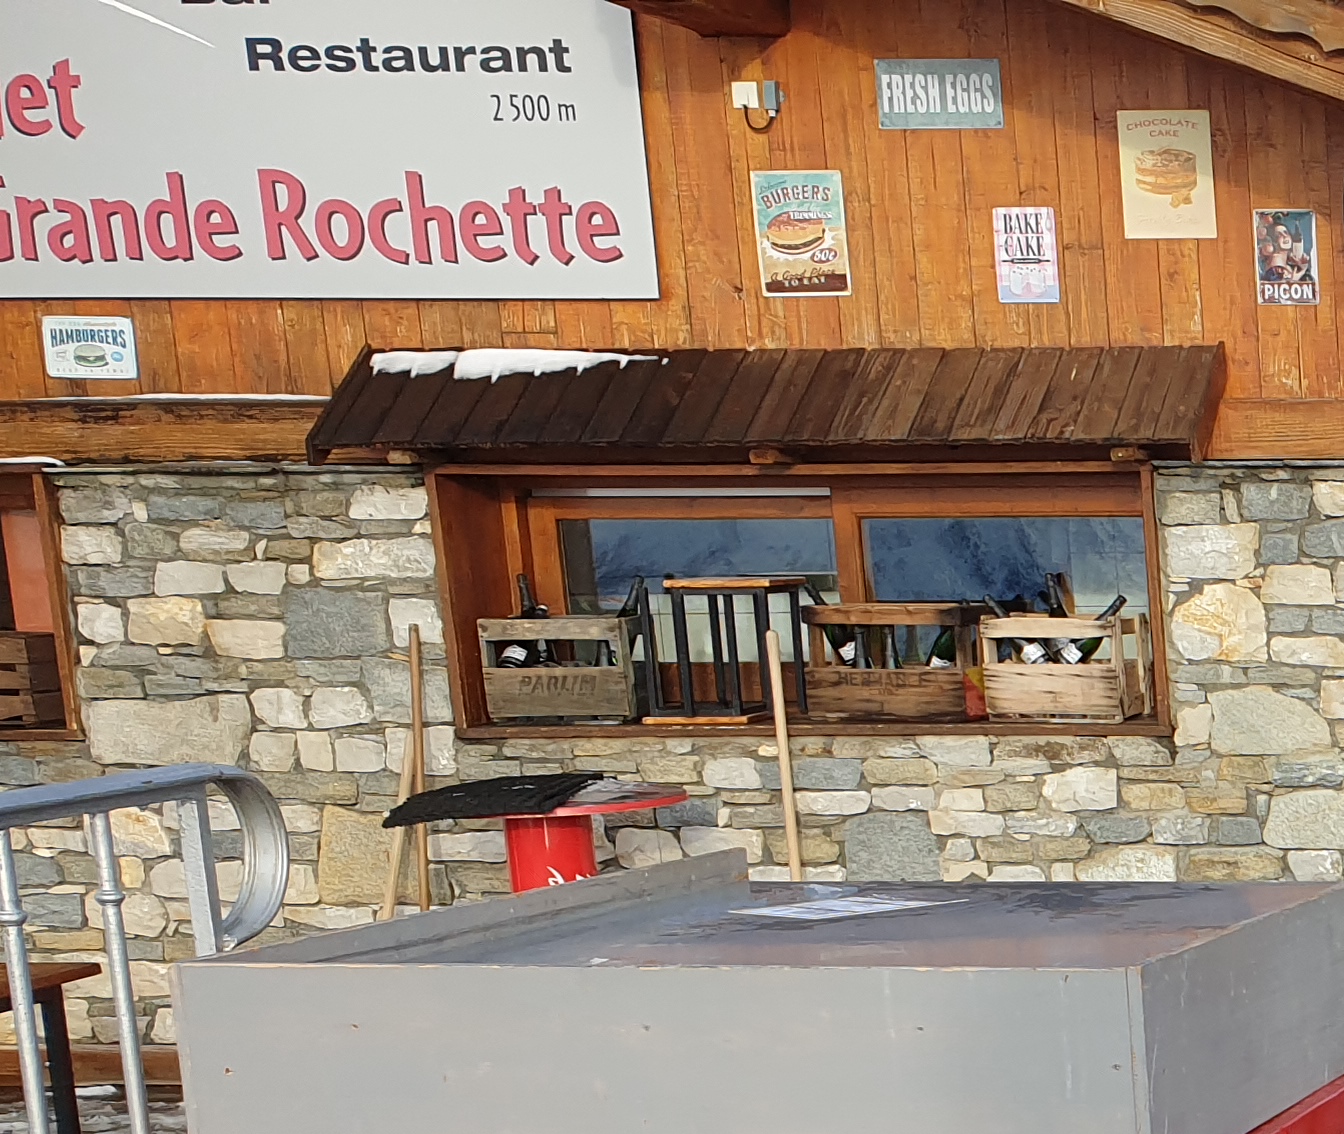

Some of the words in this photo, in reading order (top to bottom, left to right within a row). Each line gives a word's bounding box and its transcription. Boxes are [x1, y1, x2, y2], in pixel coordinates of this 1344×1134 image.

[244, 36, 573, 74] Restaurant
[0, 58, 86, 140] et
[881, 73, 941, 114] FRESH
[945, 72, 995, 114] EGGS
[558, 104, 576, 121] m
[1126, 118, 1199, 132] CHOCOLATE
[1149, 130, 1180, 138] CAKE
[760, 184, 831, 210] BURGERS
[257, 168, 624, 266] Rochette
[1003, 213, 1044, 234] BAKE
[1003, 235, 1046, 257] CAKE
[1263, 283, 1313, 300] PICON
[50, 328, 127, 349] HAMBURGERS
